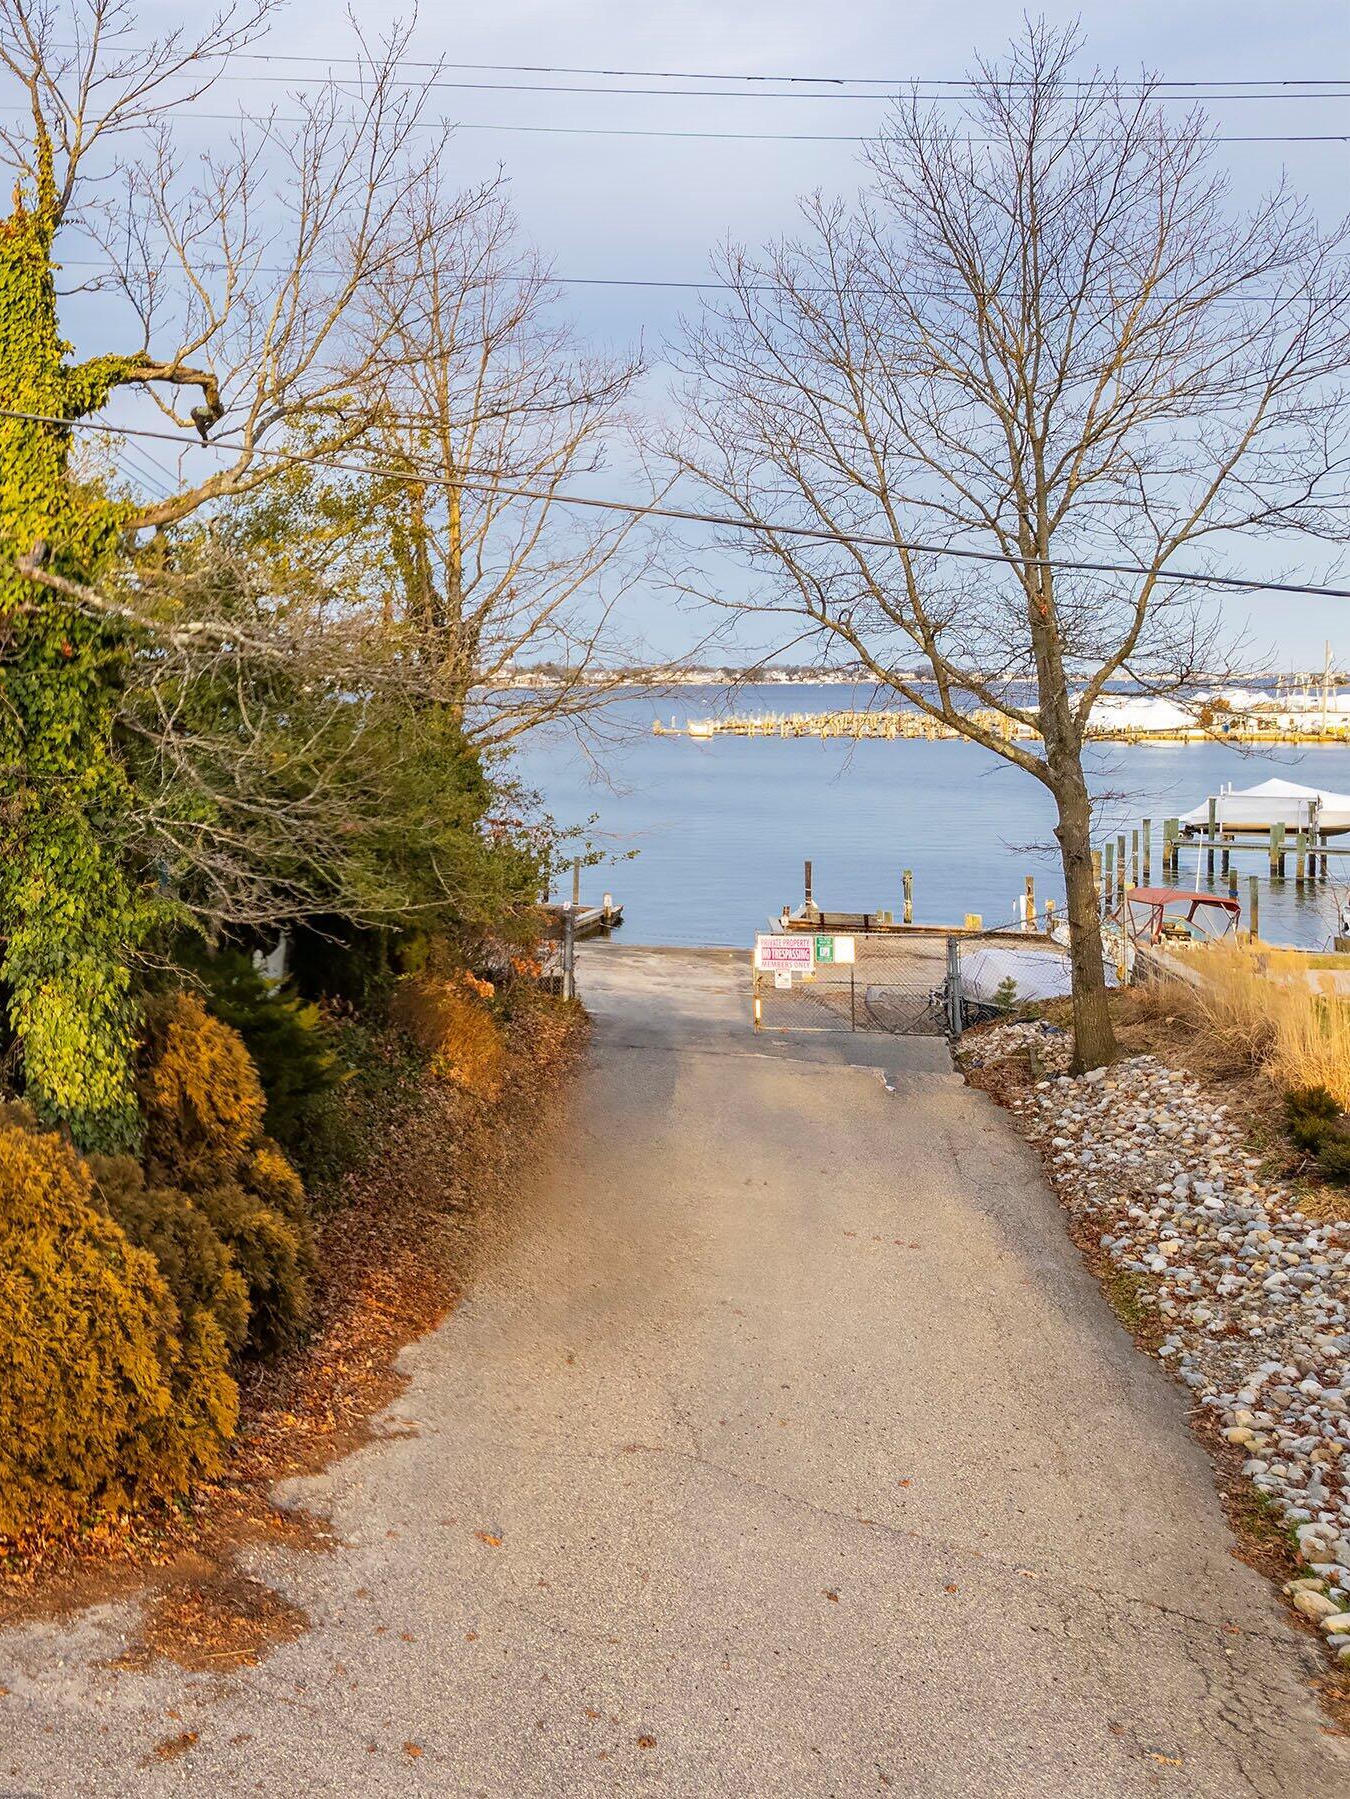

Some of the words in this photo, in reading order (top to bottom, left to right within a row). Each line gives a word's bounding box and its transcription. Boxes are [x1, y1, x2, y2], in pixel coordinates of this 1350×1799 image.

[761, 938, 782, 947] PRIVATE
[783, 938, 810, 947] PROPERTY
[762, 948, 771, 960] NO
[771, 948, 810, 960] TRESPASSING
[793, 961, 810, 969] ONLY
